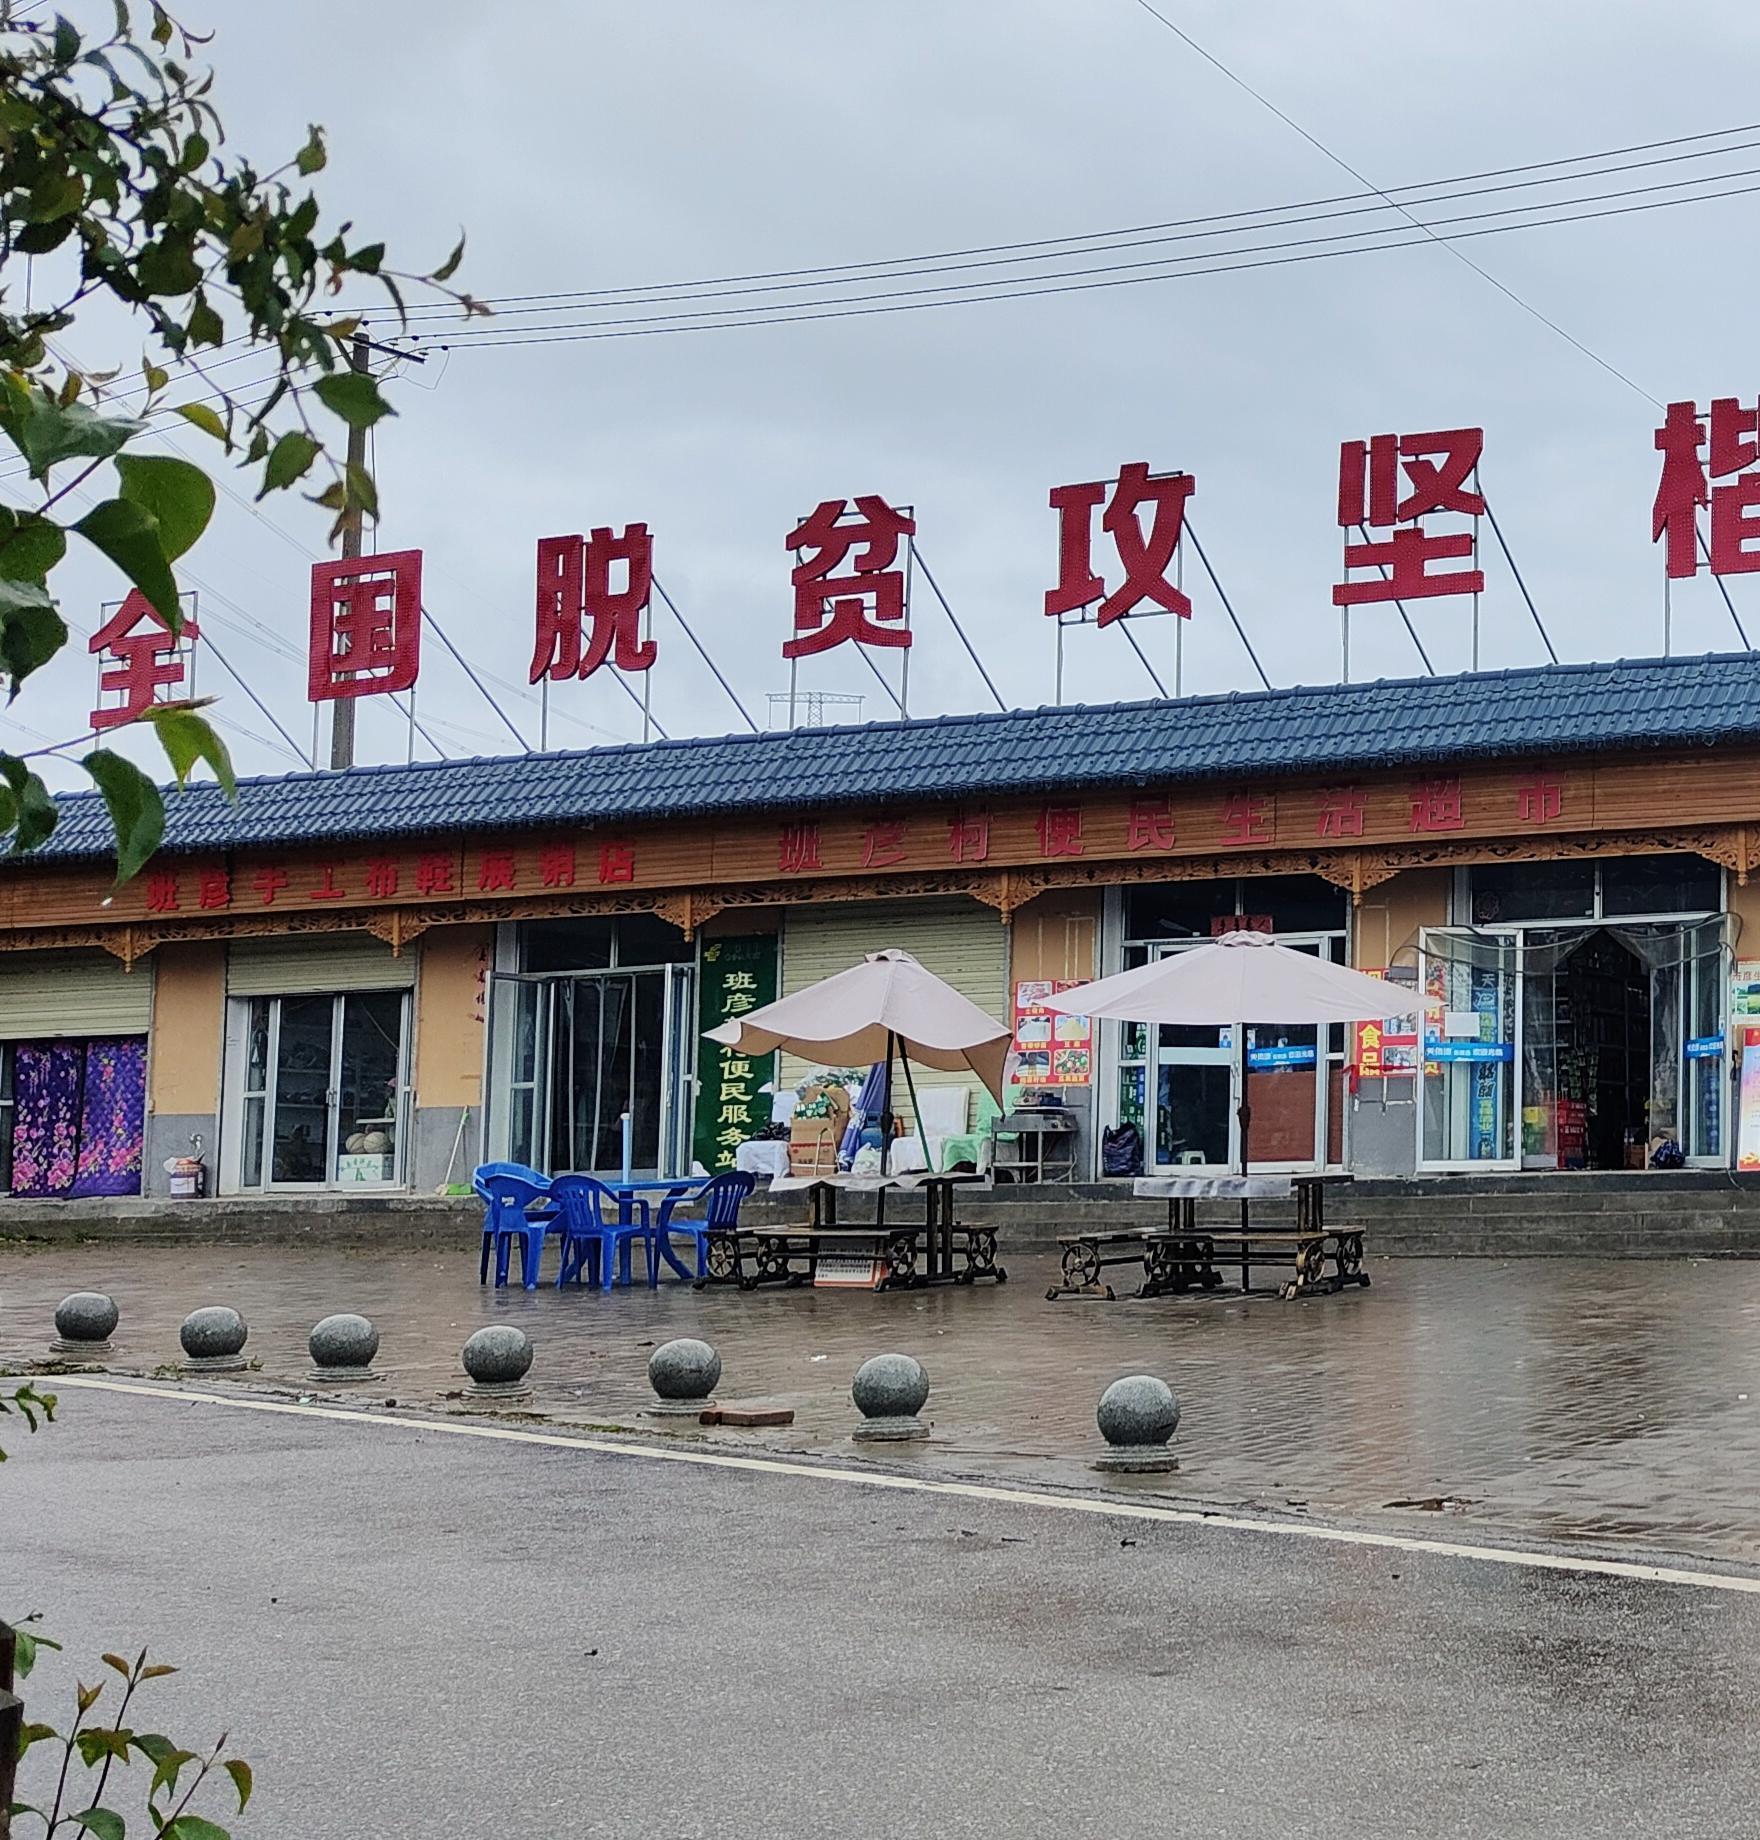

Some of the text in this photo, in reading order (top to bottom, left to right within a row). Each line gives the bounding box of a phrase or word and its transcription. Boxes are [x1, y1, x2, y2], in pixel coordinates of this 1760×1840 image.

[778, 765, 1568, 873] 班彦村便民生活超市
[715, 970, 758, 1169] 班彦便民服务站
